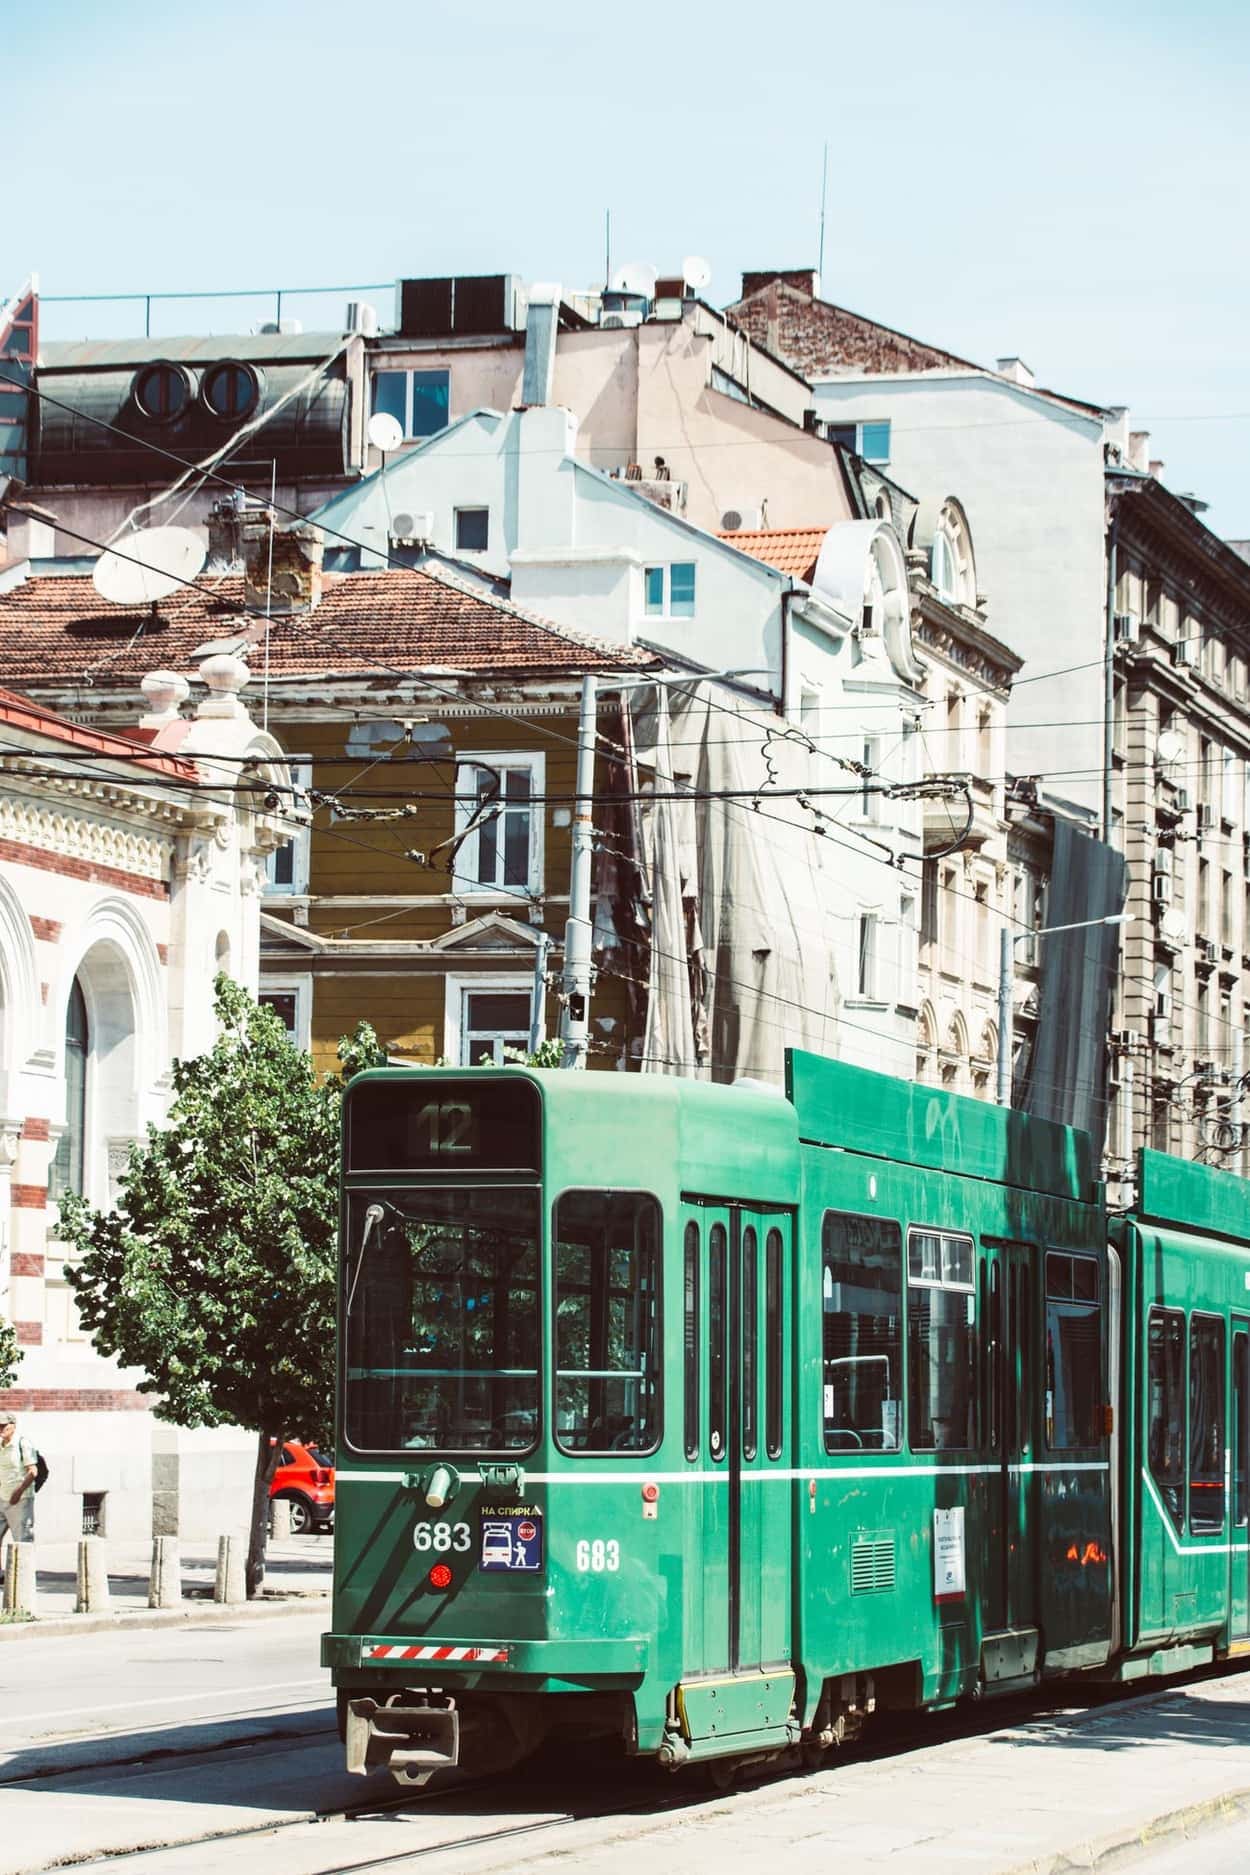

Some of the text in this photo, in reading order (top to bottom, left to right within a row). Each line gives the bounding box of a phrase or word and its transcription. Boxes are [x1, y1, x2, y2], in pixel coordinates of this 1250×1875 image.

[417, 1103, 472, 1151] 12
[481, 1506, 538, 1515] НА СПИРКА
[413, 1521, 472, 1552] 683
[576, 1539, 620, 1572] 683
